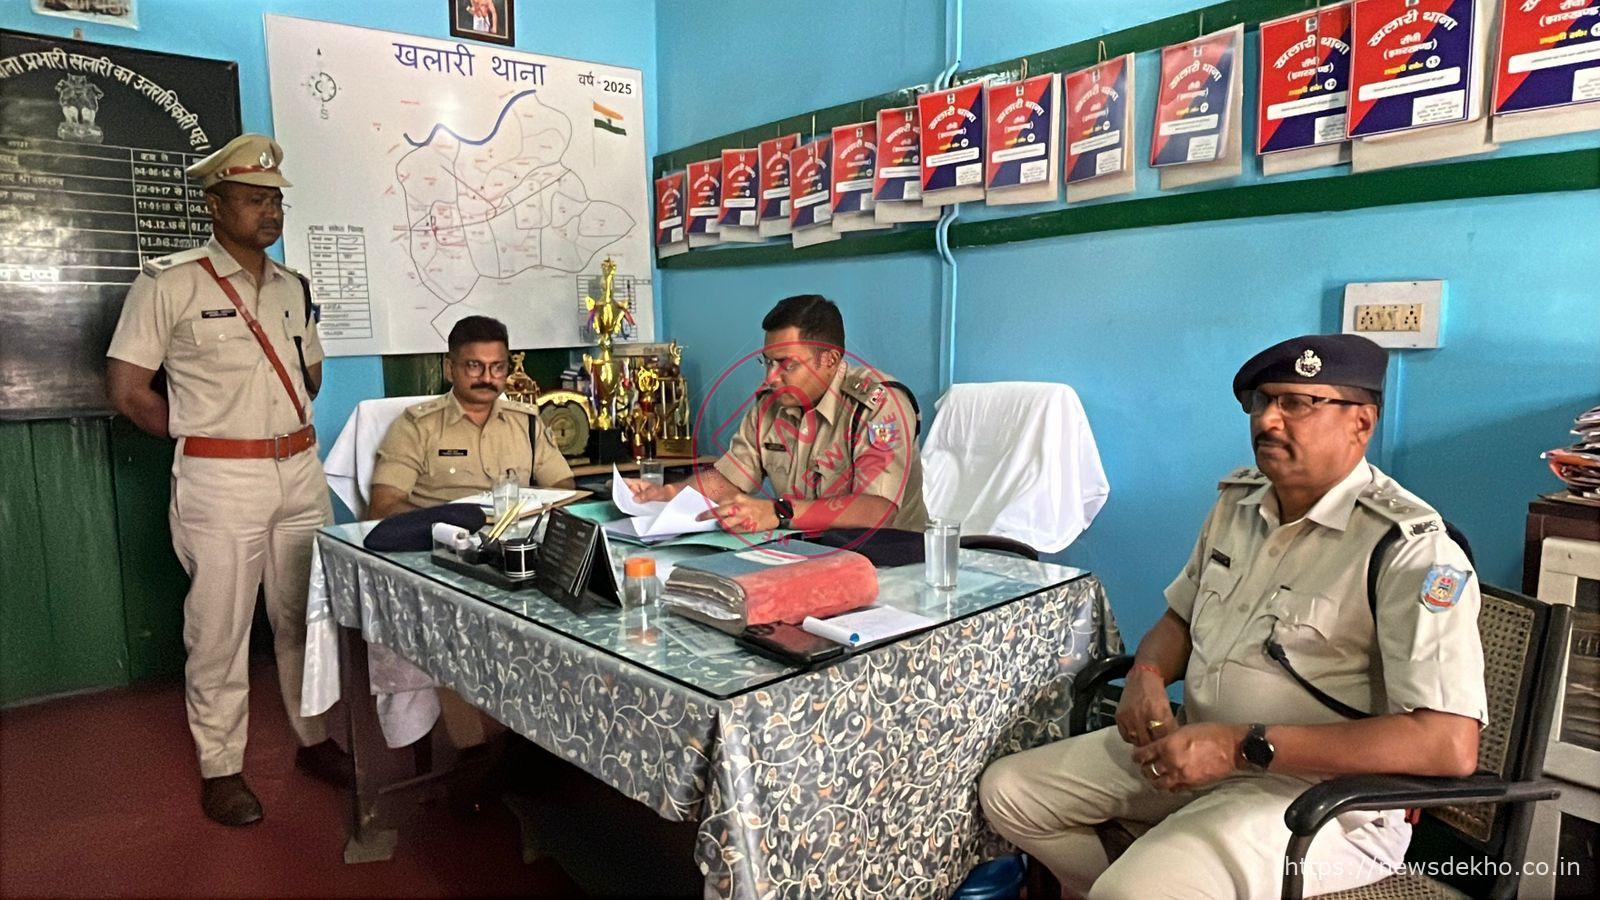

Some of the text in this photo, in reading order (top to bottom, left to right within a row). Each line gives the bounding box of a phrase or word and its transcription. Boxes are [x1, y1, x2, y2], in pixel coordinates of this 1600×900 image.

[1367, 9, 1458, 46] खलारी थाना
[20, 47, 68, 71] प्रभारी
[113, 65, 135, 87] का
[392, 43, 547, 86] खलारी थाना
[1273, 34, 1350, 69] खलारी थाना
